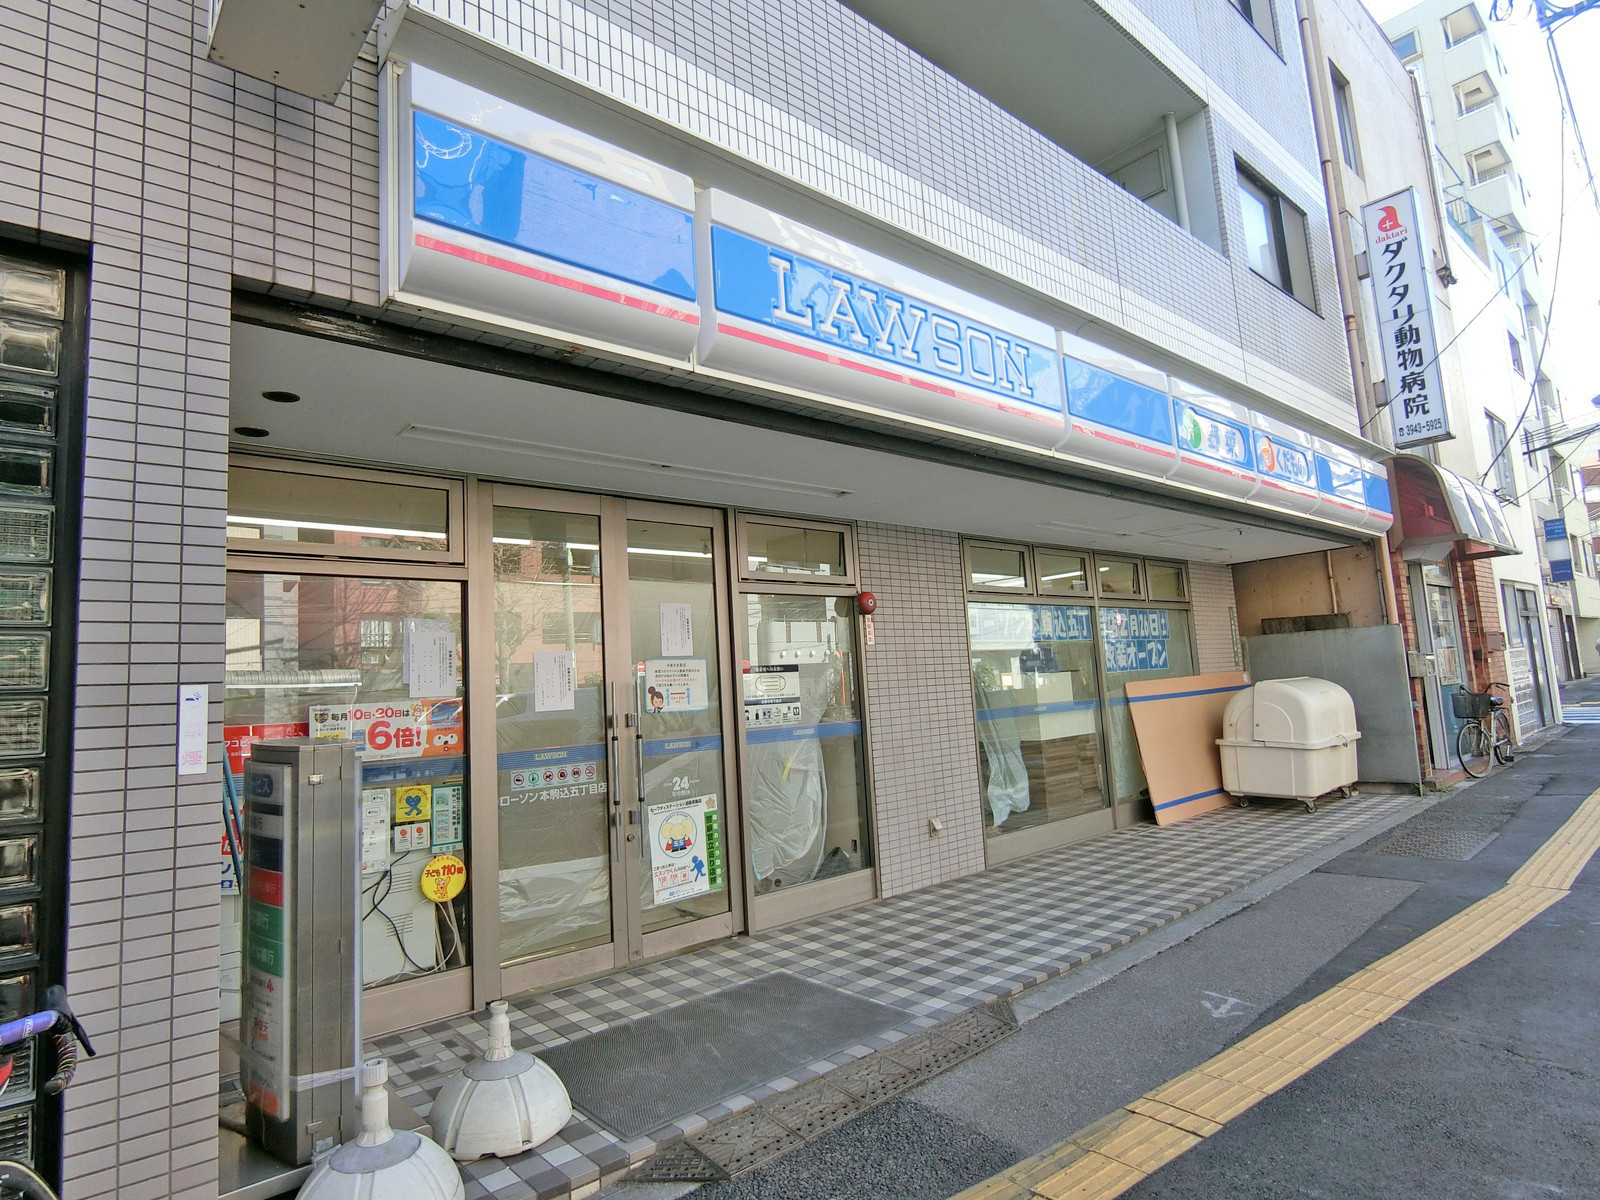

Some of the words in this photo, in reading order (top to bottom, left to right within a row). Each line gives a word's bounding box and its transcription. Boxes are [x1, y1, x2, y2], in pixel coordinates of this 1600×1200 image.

[1375, 227, 1408, 244] daktari
[767, 251, 1035, 399] LAWSON
[1381, 236, 1431, 420] ダクタリ動物病院
[1406, 418, 1443, 437] 3943-5925
[1275, 447, 1307, 480] くだもの
[534, 750, 568, 760] LAWSON
[672, 775, 690, 791] 24
[500, 782, 607, 807] ローソン本駒込五丁目店
